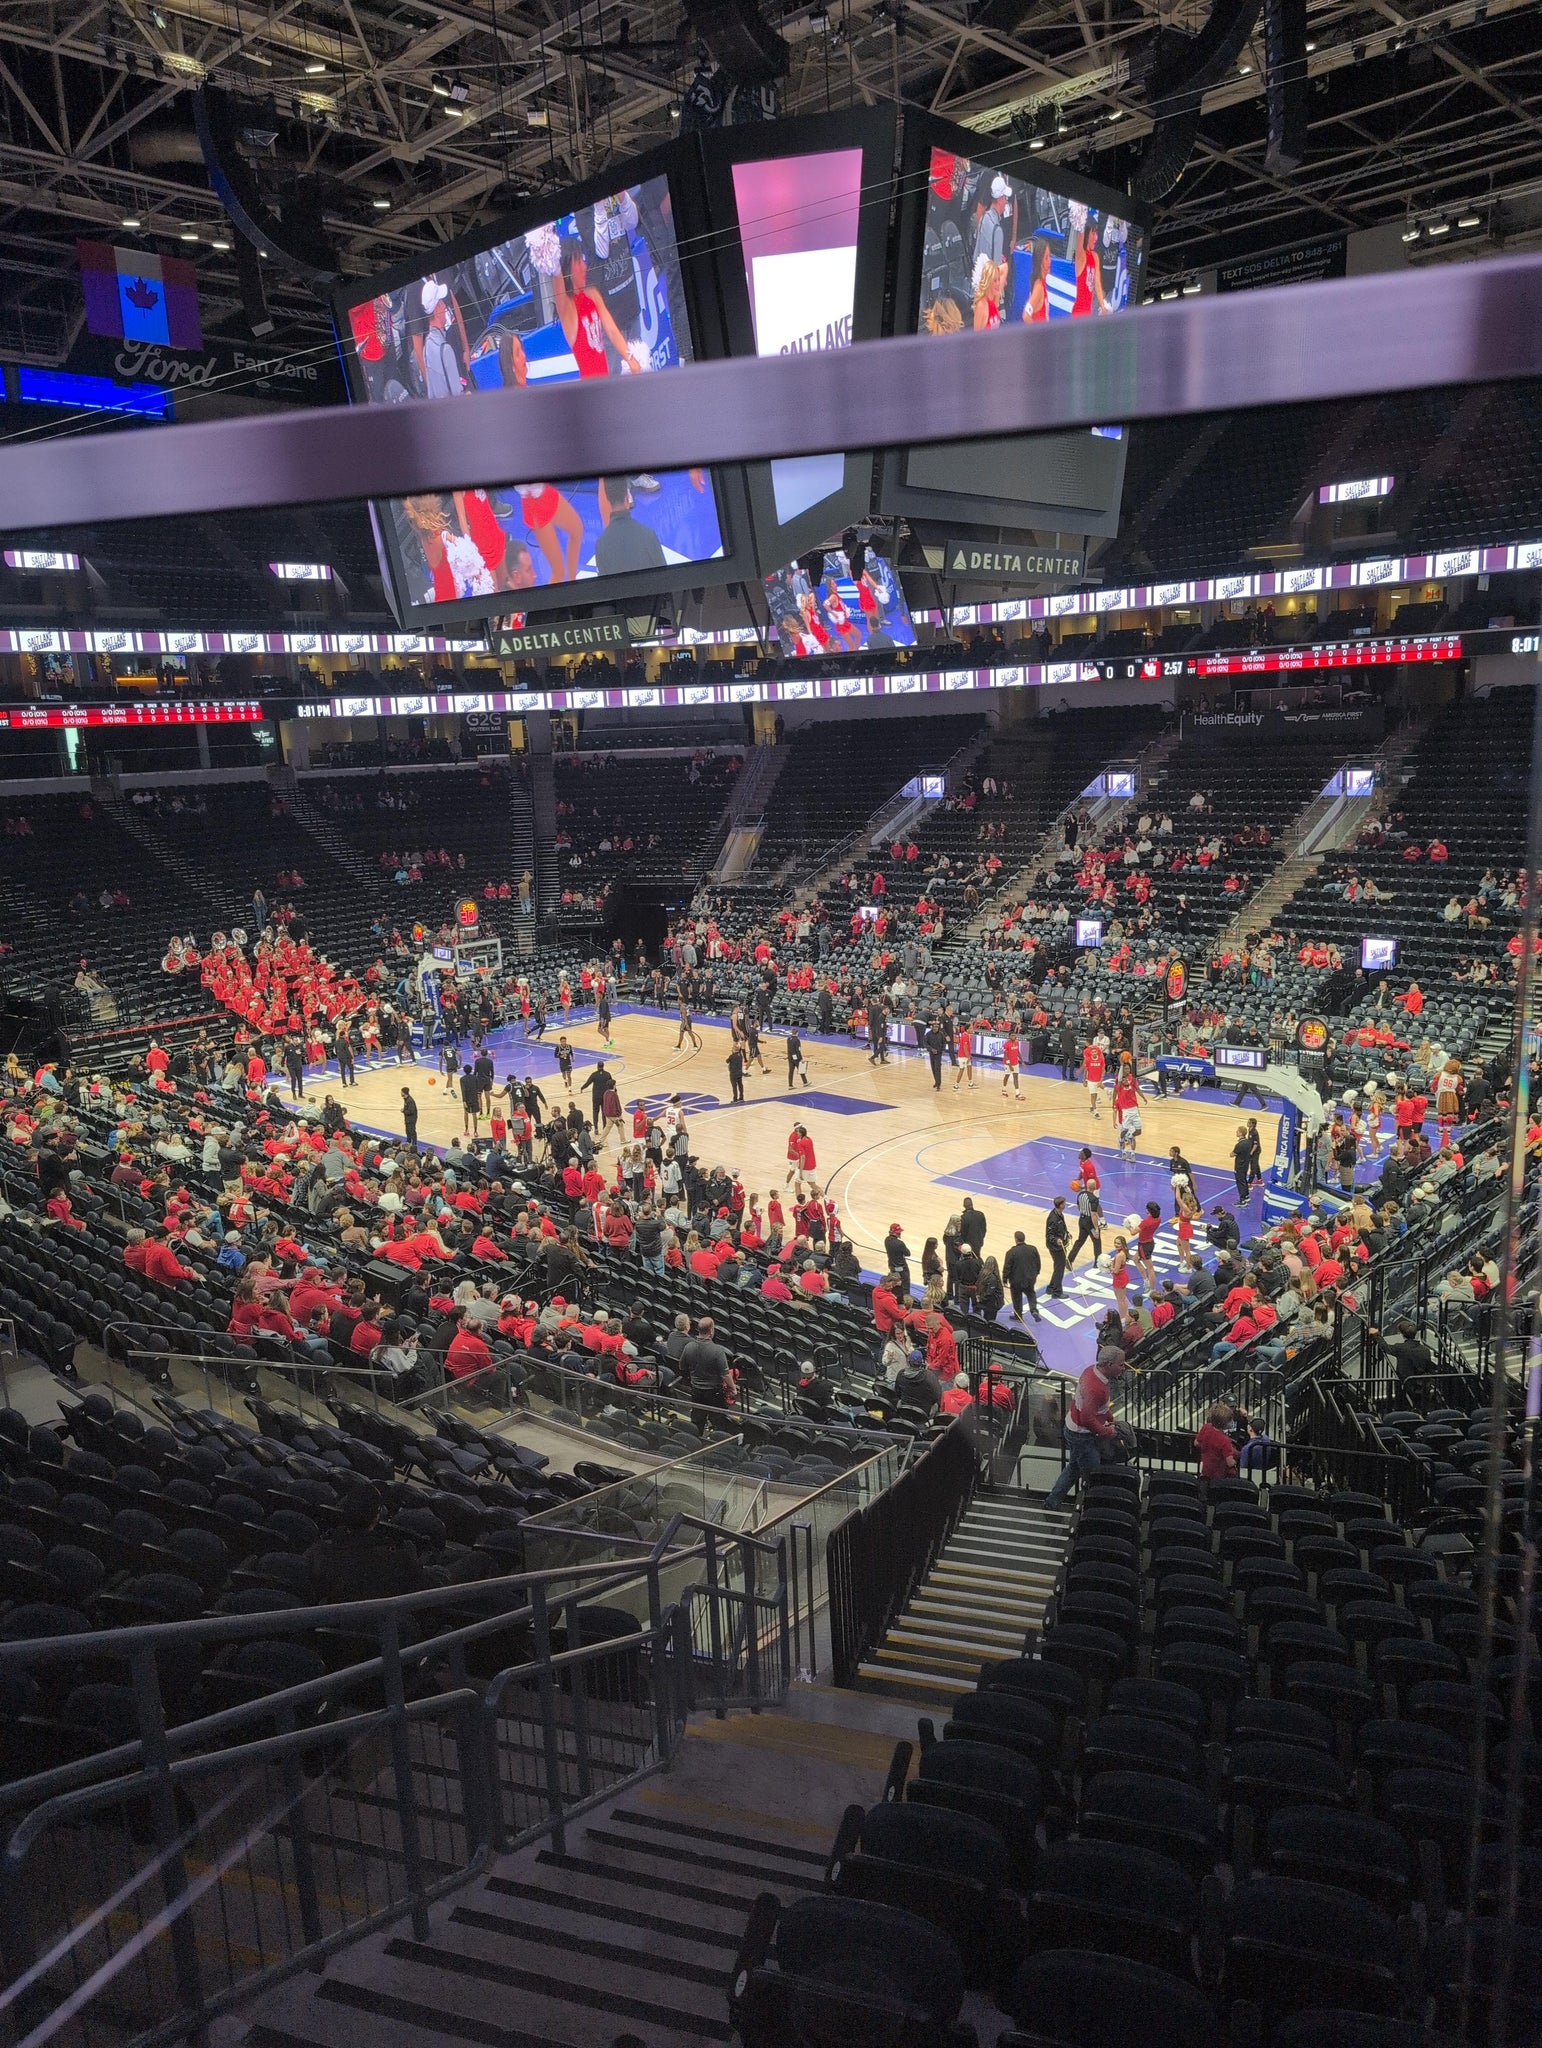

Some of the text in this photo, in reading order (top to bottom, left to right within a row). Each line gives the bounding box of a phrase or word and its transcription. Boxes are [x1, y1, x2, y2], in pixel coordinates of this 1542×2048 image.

[1222, 267, 1243, 280] TEXT
[1244, 263, 1262, 275] SOS
[1263, 255, 1290, 269] DELTA
[1291, 251, 1304, 262] TO
[816, 313, 853, 352] LAKE
[115, 340, 217, 388] Ford
[233, 352, 317, 380] Fan Zone
[970, 552, 1079, 575] DELTA CENTER
[511, 624, 622, 651] DELTA CENTER
[1512, 636, 1539, 653] 8:01
[1106, 666, 1114, 679] 0
[1127, 664, 1134, 678] 0
[1164, 661, 1183, 676] 2:57
[299, 704, 331, 717] 8:01 PM
[1321, 711, 1346, 719] AMERICA
[466, 713, 502, 727] G2G
[1194, 710, 1264, 727] HealthEquity
[461, 911, 475, 923] 30
[447, 1050, 453, 1058] 5
[1443, 1078, 1454, 1088] 96
[516, 1089, 522, 1098] 4
[667, 1115, 676, 1126] 32
[1276, 1114, 1291, 1178] AMRICA FIRST
[664, 1169, 669, 1181] 3
